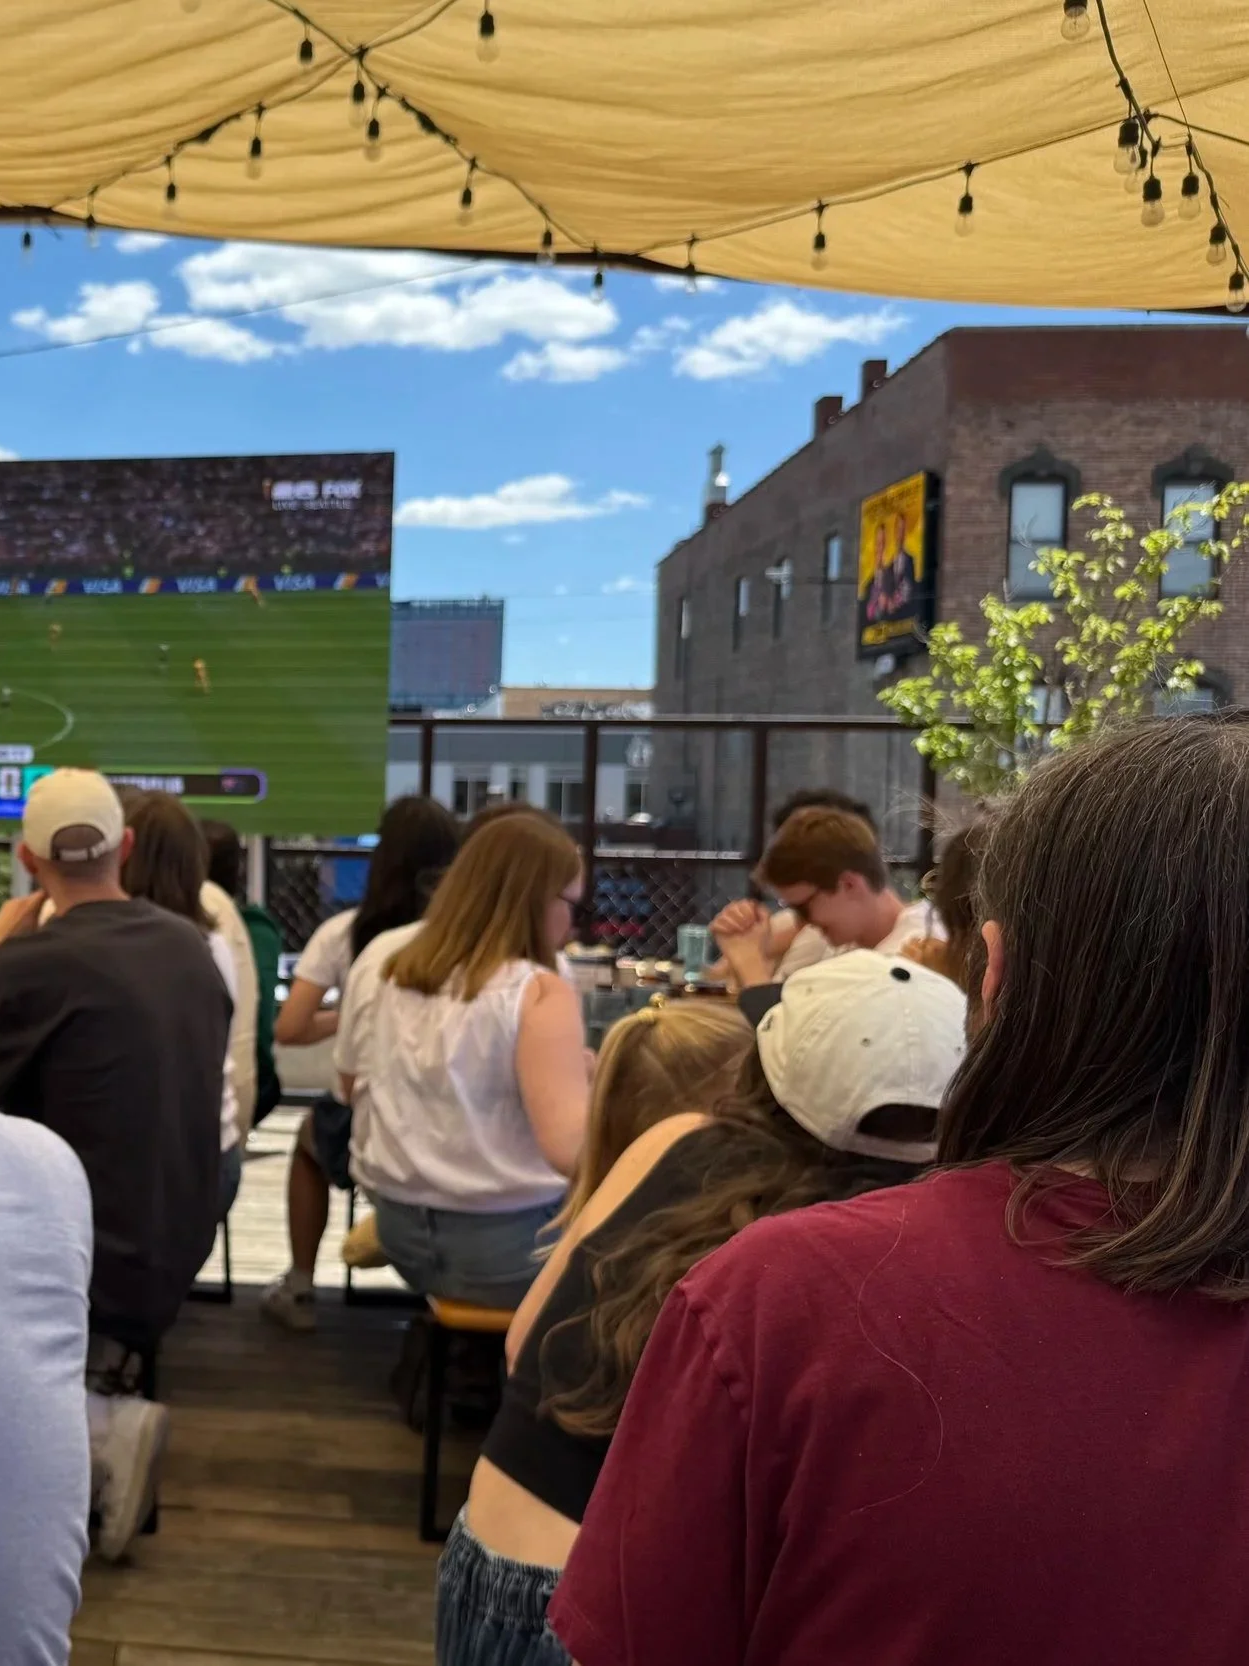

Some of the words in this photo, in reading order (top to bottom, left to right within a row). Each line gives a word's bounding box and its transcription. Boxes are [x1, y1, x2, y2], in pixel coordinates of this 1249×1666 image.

[82, 577, 123, 595] VISA
[176, 575, 218, 593] VISA
[273, 573, 316, 591] VISA
